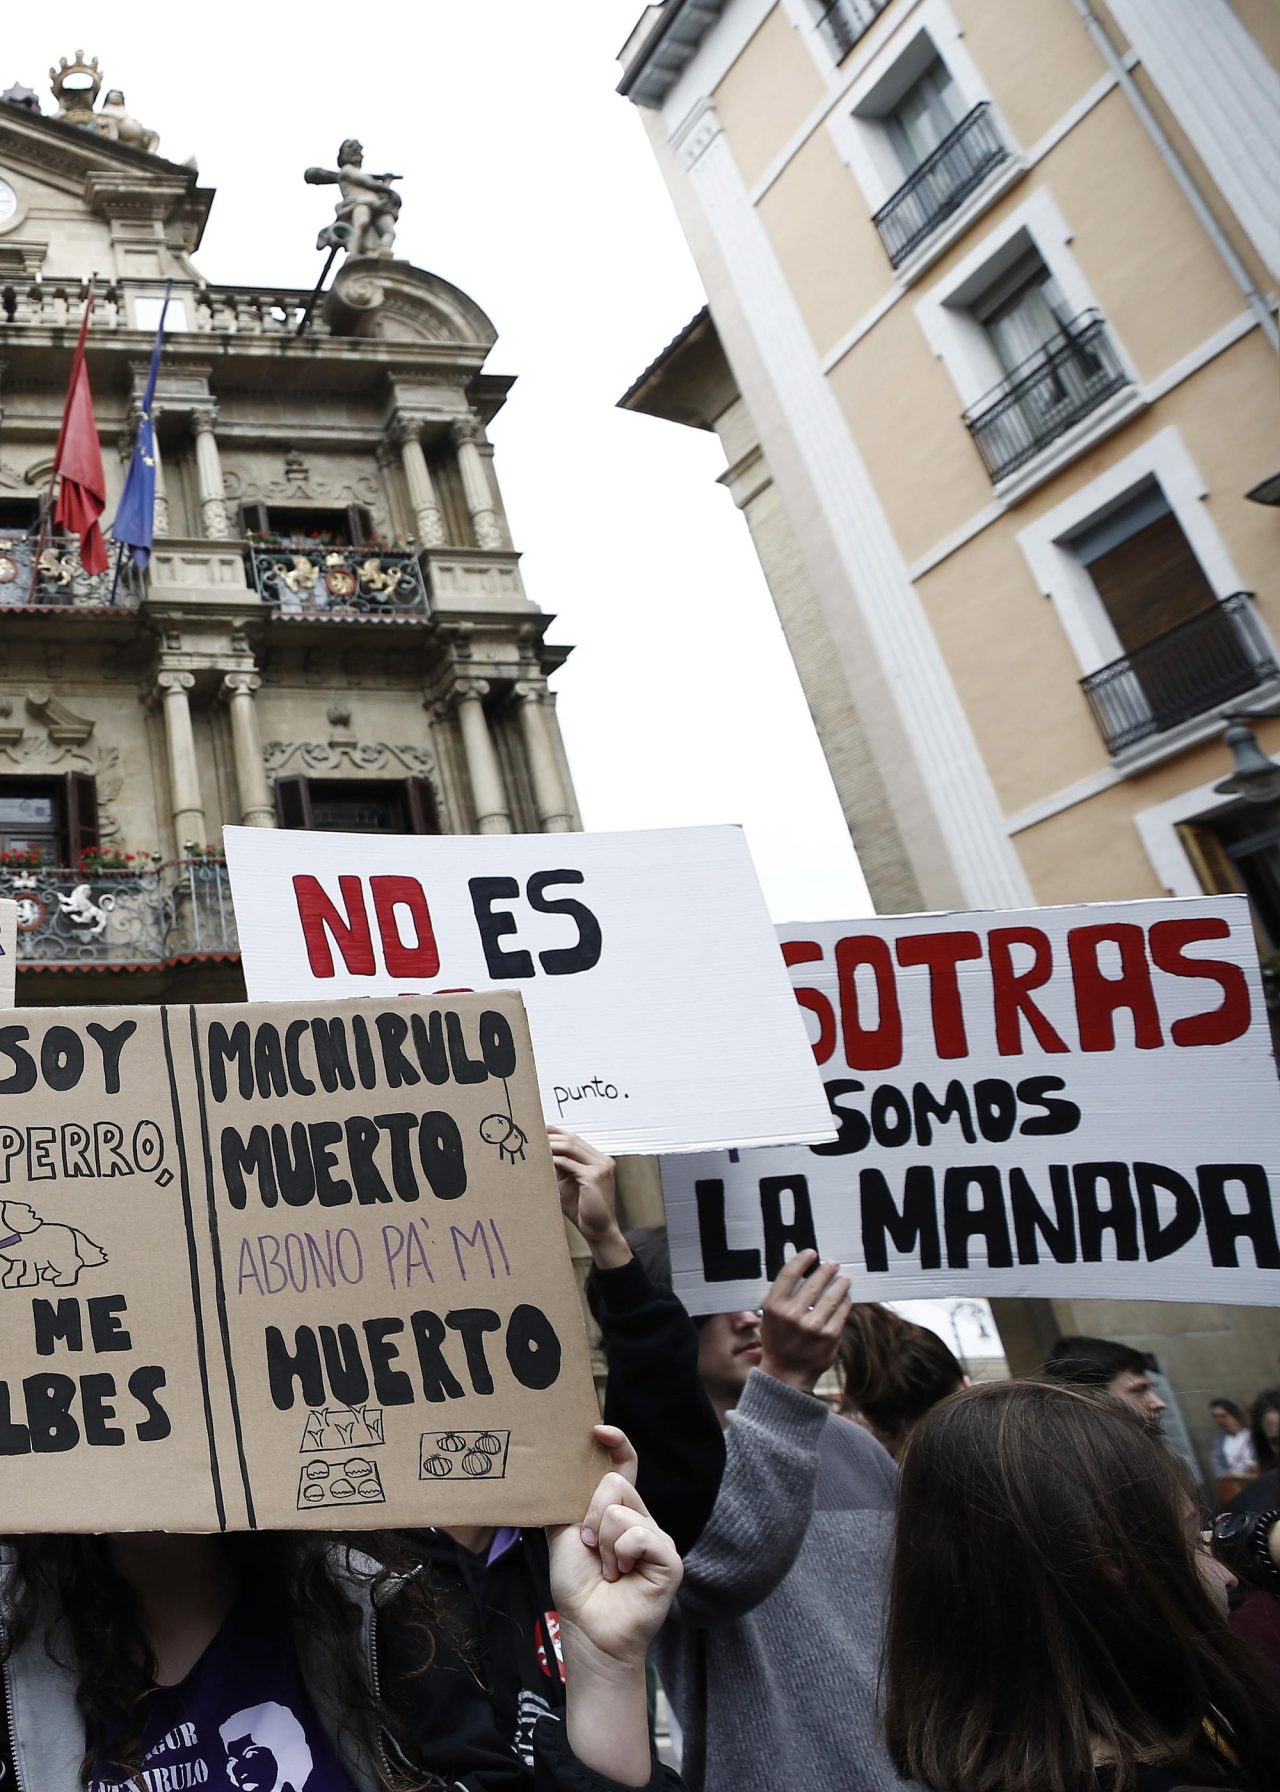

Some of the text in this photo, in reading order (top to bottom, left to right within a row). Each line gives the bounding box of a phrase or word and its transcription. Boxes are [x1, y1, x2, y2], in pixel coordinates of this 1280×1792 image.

[292, 868, 602, 979] NO ES
[208, 1010, 516, 1102] MACHIRULO
[555, 1076, 630, 1118] punto.
[220, 1110, 468, 1209] MUERTO
[810, 1075, 1081, 1156] SOMOS
[237, 1227, 364, 1295] ABONO
[451, 1218, 512, 1281] MI
[695, 1161, 1280, 1283] LA MANADA
[34, 1293, 133, 1357] ME
[265, 1303, 562, 1410] HUERTO
